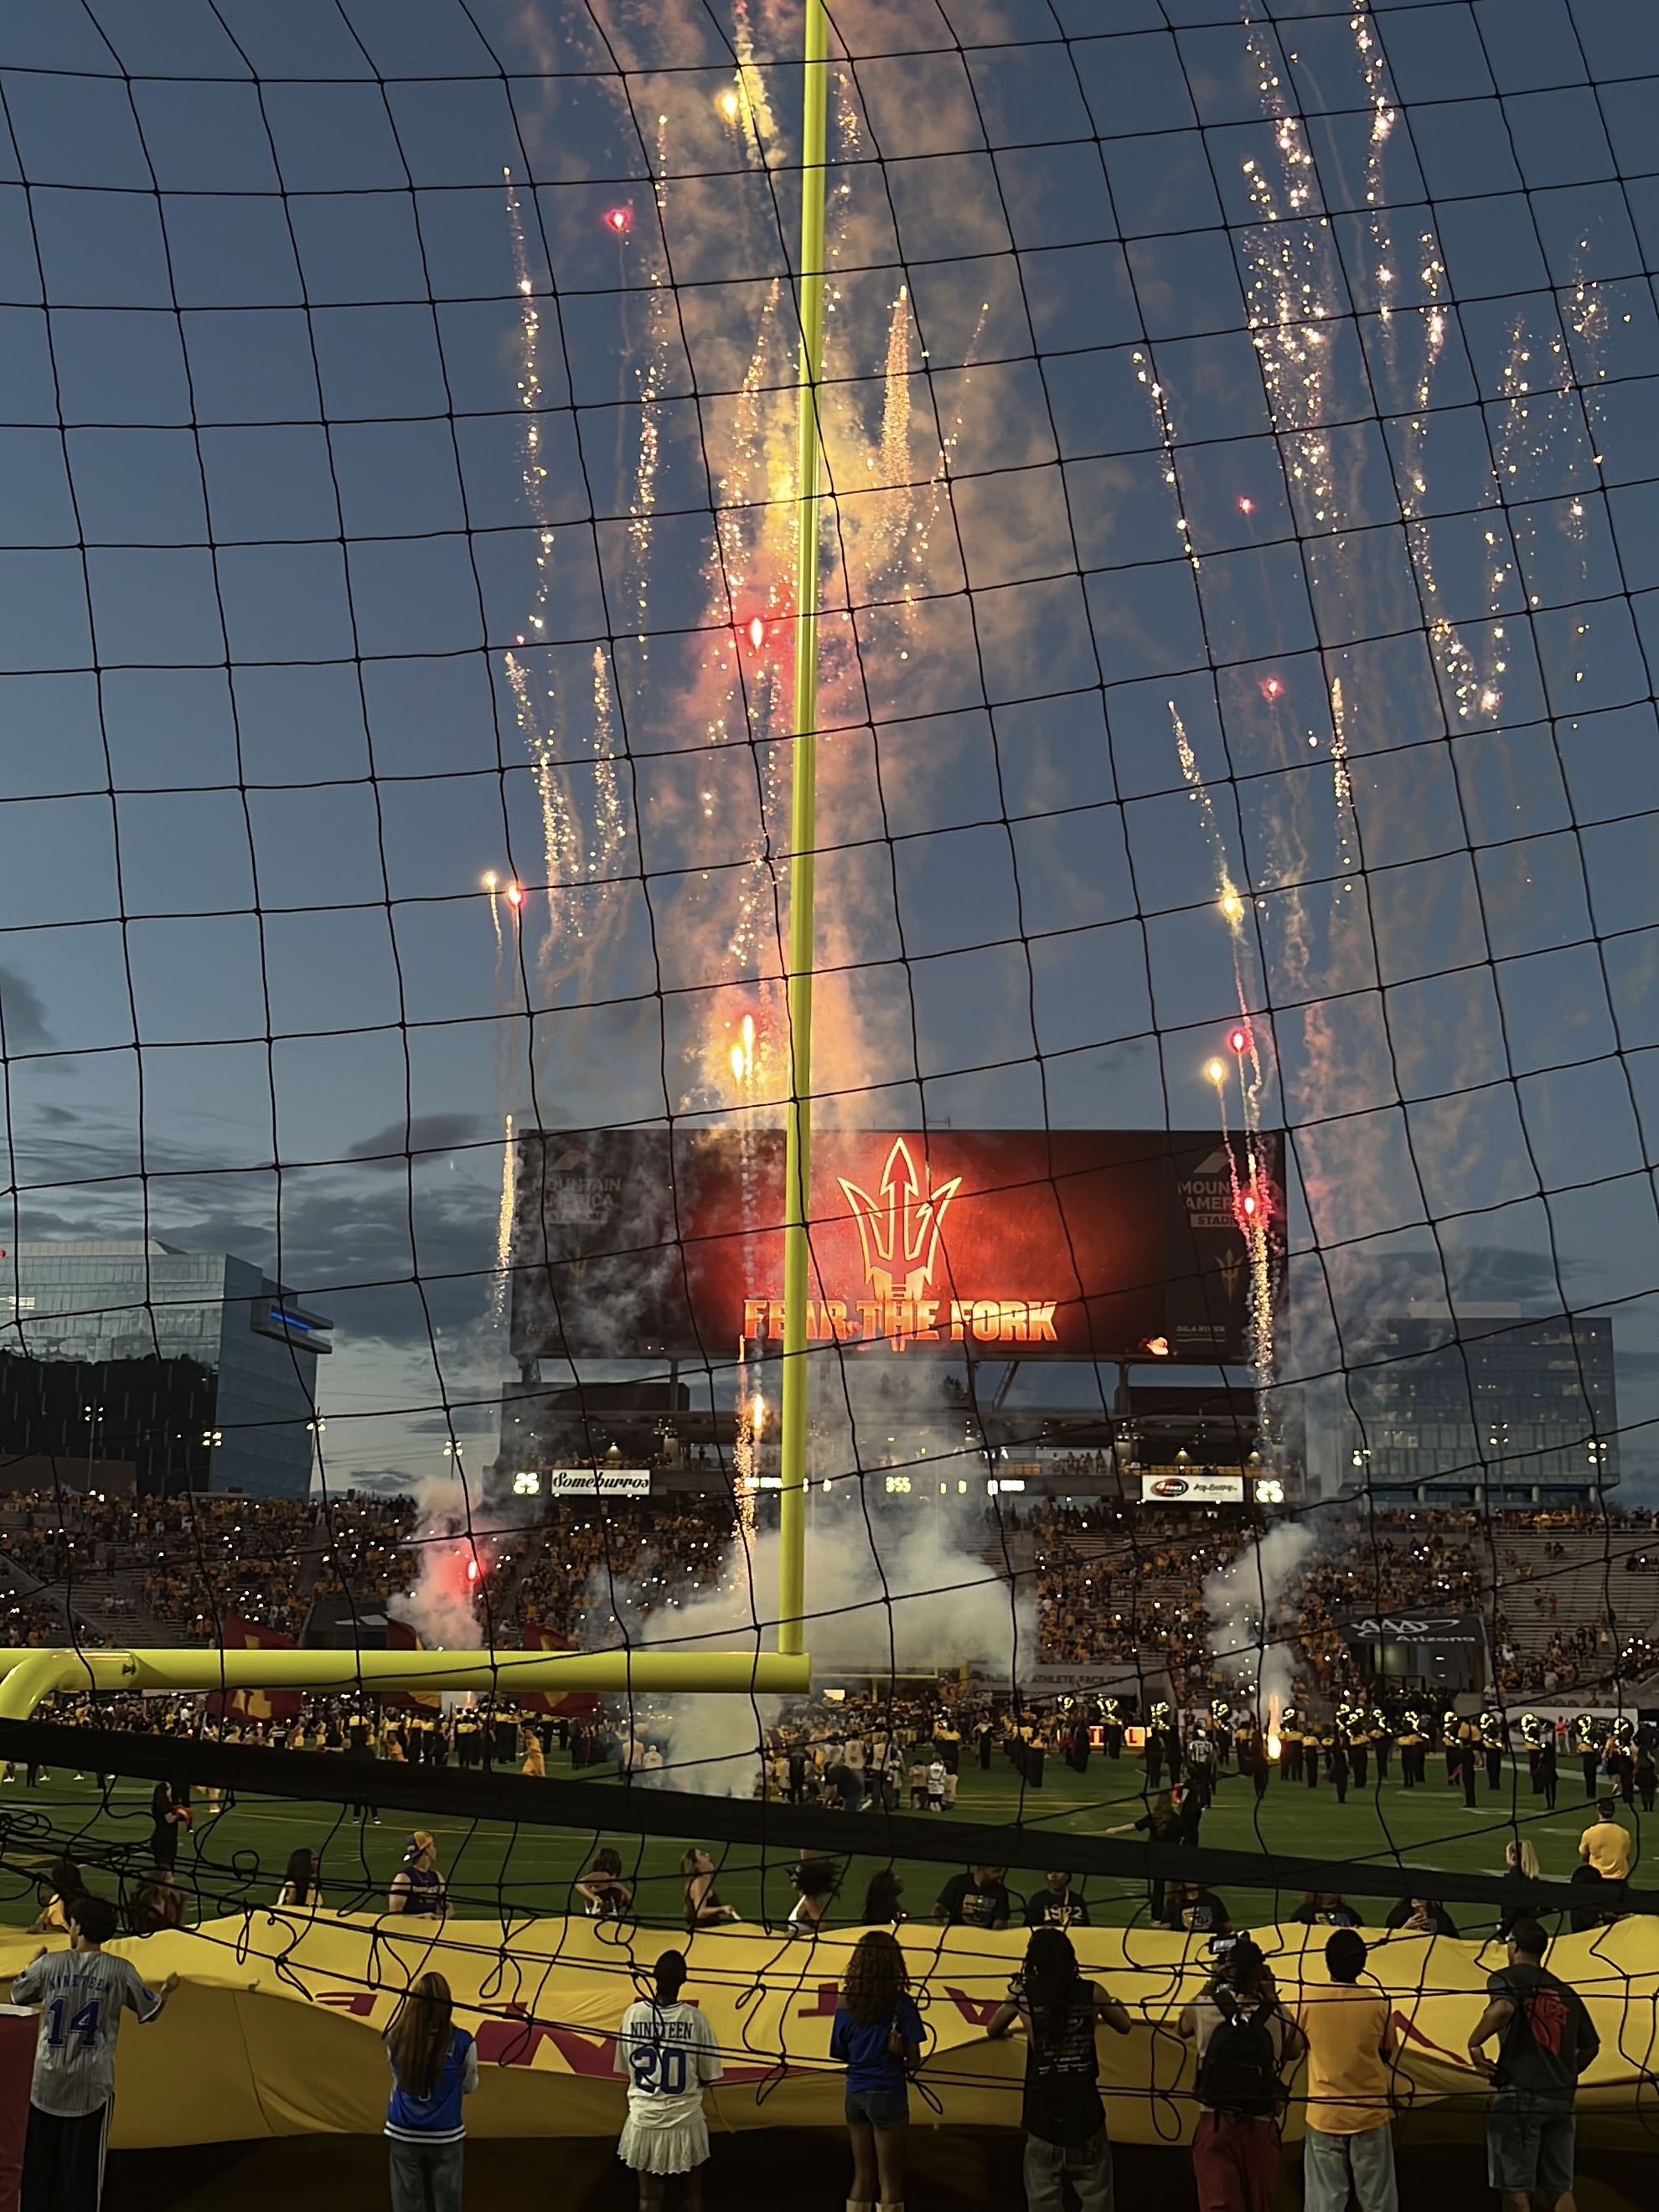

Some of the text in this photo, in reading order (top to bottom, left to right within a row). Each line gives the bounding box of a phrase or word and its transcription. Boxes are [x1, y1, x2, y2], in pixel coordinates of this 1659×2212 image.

[1183, 1196, 1233, 1210] AMER
[856, 1300, 939, 1341] THE
[950, 1300, 1058, 1341] FORK
[553, 1471, 649, 1488] Someburros
[47, 1996, 101, 2048] 14
[633, 2047, 686, 2095] 20
